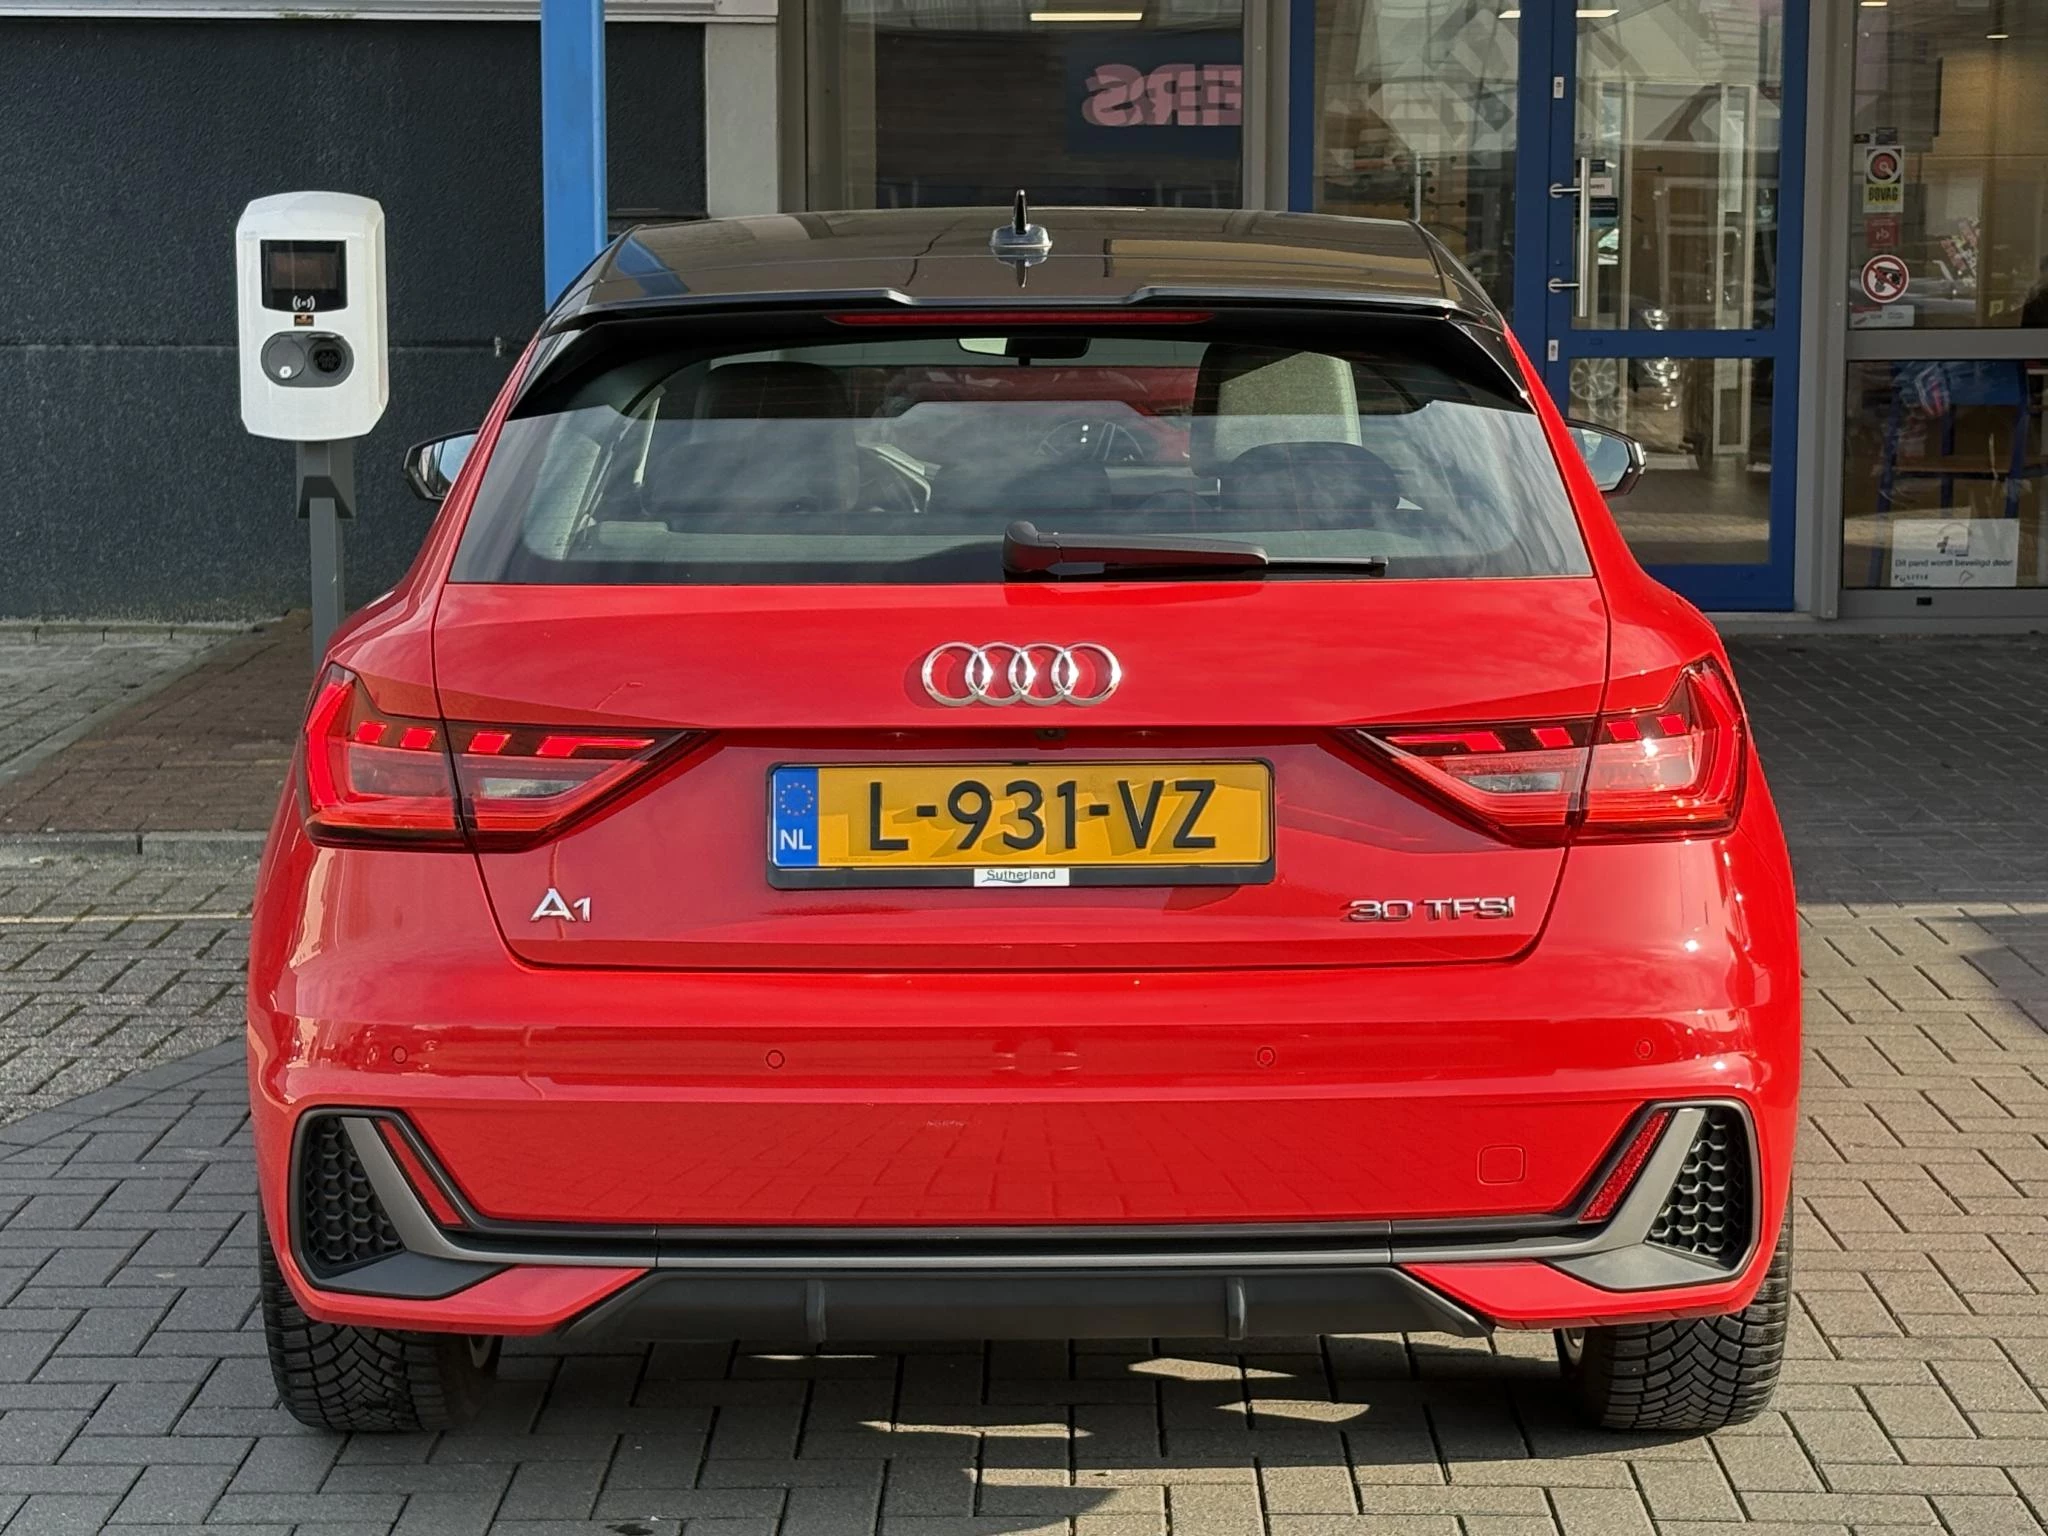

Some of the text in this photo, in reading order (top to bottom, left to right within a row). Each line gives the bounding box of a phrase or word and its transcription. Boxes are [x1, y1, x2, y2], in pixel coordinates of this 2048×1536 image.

[1868, 186, 1899, 202] BOVAG
[869, 780, 1216, 851] L-931-VZ
[780, 828, 812, 850] NL
[986, 869, 1056, 882] Sutherland
[529, 887, 592, 922] A1
[1348, 895, 1516, 922] 30 TFSI
